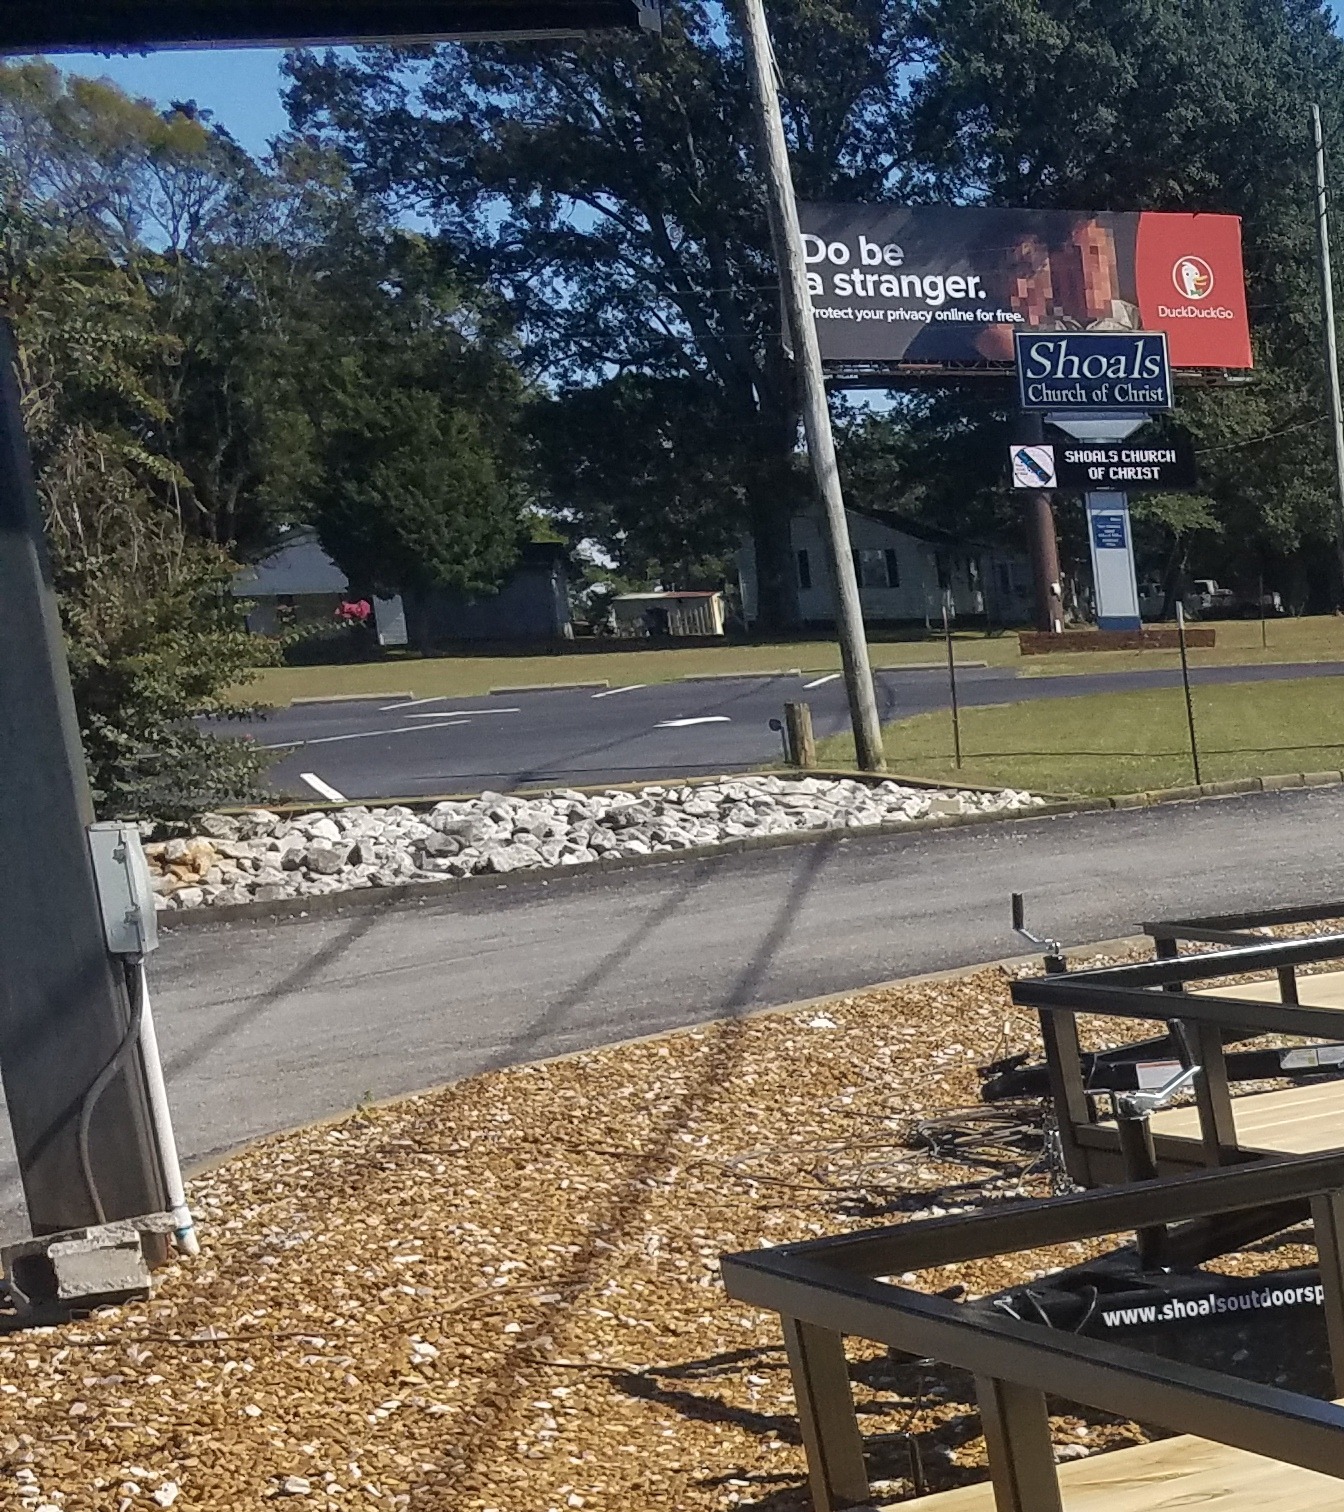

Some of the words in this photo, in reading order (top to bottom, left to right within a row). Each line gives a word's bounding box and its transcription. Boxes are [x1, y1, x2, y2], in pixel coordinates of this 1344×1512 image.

[800, 233, 850, 265] Do
[858, 235, 904, 267] be
[806, 272, 824, 295] a
[833, 268, 987, 306] stranger.
[857, 309, 885, 322] your
[887, 308, 932, 323] privacy
[935, 308, 973, 321] online
[976, 308, 993, 322] for
[996, 309, 1025, 323] free.
[1158, 305, 1234, 319] DuckDuckGo
[1026, 339, 1161, 379] Shoals
[1028, 382, 1086, 402] Church
[1092, 382, 1109, 402] of
[1114, 384, 1164, 402] Christ
[1064, 450, 1118, 463] SHOALS
[1121, 450, 1176, 463] CHURCH
[1088, 467, 1105, 480] OF
[1109, 467, 1160, 480] CHRIST
